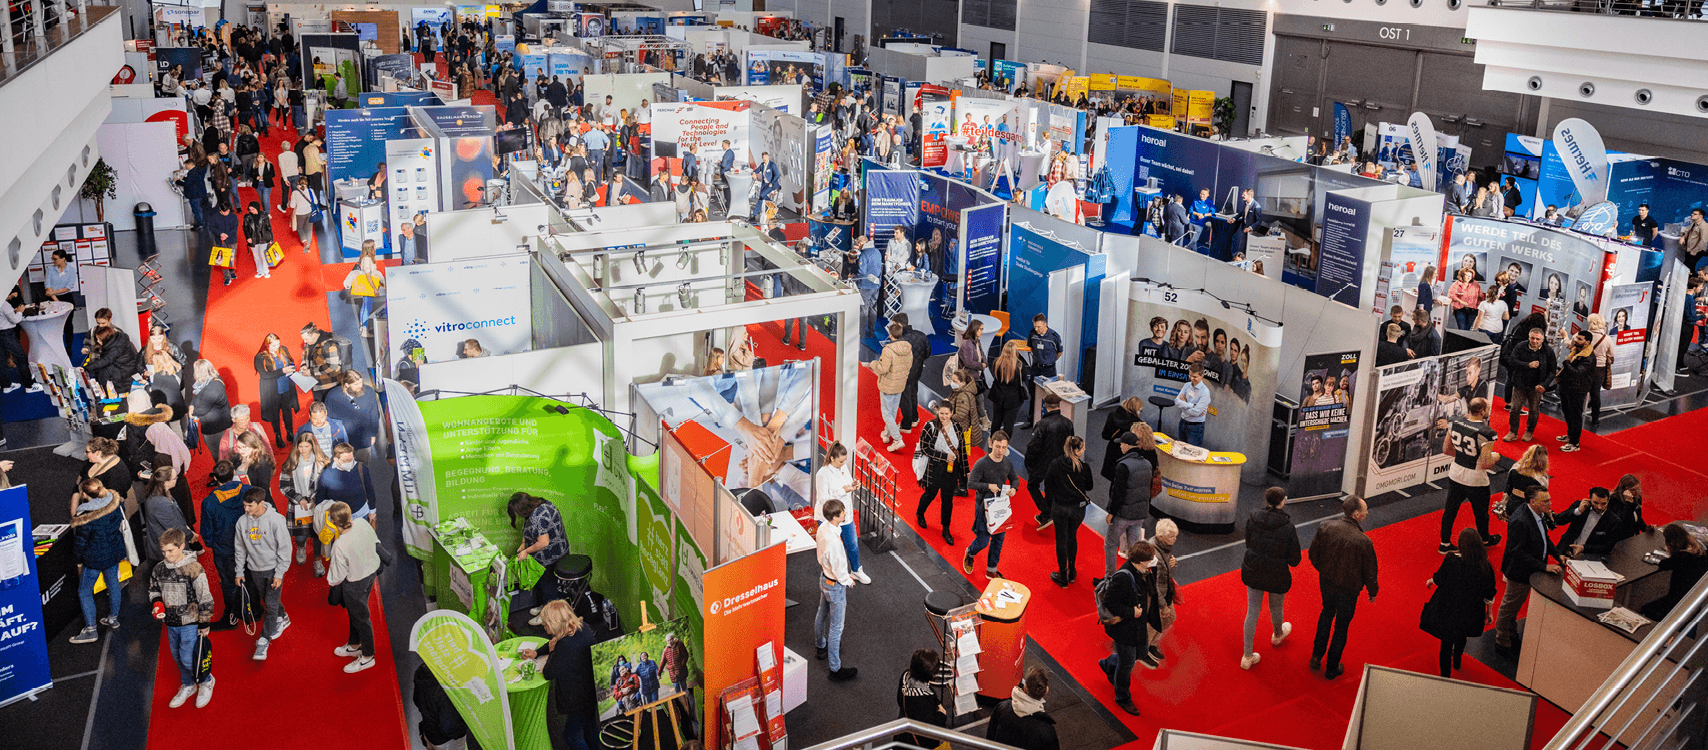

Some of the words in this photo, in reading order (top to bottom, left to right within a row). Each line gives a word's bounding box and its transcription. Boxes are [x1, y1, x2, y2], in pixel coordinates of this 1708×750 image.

[1379, 26, 1402, 39] OST
[1405, 29, 1410, 40] 1
[691, 122, 714, 130] People
[682, 129, 726, 138] Technologies
[1141, 134, 1167, 147] heroal
[1140, 156, 1151, 164] Unser
[1151, 159, 1161, 167] Team
[1161, 161, 1175, 171] wächst,
[1181, 167, 1194, 176] dabei!
[1675, 170, 1691, 178] CTO
[921, 200, 960, 224] EMPOWE
[1328, 202, 1356, 216] heroal
[927, 215, 933, 223] to
[933, 218, 945, 226] start
[946, 220, 957, 230] your
[1394, 229, 1405, 238] 27
[1461, 223, 1508, 238] WERDE
[1512, 230, 1538, 245] TEIL
[1541, 237, 1562, 251] DES
[1463, 237, 1506, 251] GUTEN
[1511, 244, 1555, 263] WERKS.
[1164, 291, 1178, 303] 52
[435, 315, 516, 333] vitroconnect
[1144, 348, 1157, 357] MIT
[1137, 356, 1179, 369] GEBALLTER
[1305, 411, 1319, 420] DASS
[1319, 409, 1330, 418] WIR
[1330, 408, 1346, 416] KEINE
[442, 418, 517, 429] WOHNANGEBOTE
[519, 418, 537, 427] UND
[1299, 418, 1330, 428] UNTERSCHIEDE
[1330, 415, 1348, 423] MACHEN.
[443, 426, 520, 439] UNTERSTÜTZUNG
[521, 426, 539, 436] FÜR
[1452, 430, 1477, 457] 23
[505, 452, 540, 460] Behinderung
[445, 466, 503, 478] BEGEGNUNG,
[505, 466, 552, 478] BERATUNG,
[446, 476, 486, 488] BILDUNG
[1376, 473, 1416, 490] DMGMORI.COM
[1584, 582, 1613, 590] LOSBOX
[724, 578, 779, 608] Dresselhaus
[732, 593, 768, 612] Mehrwertmacher
